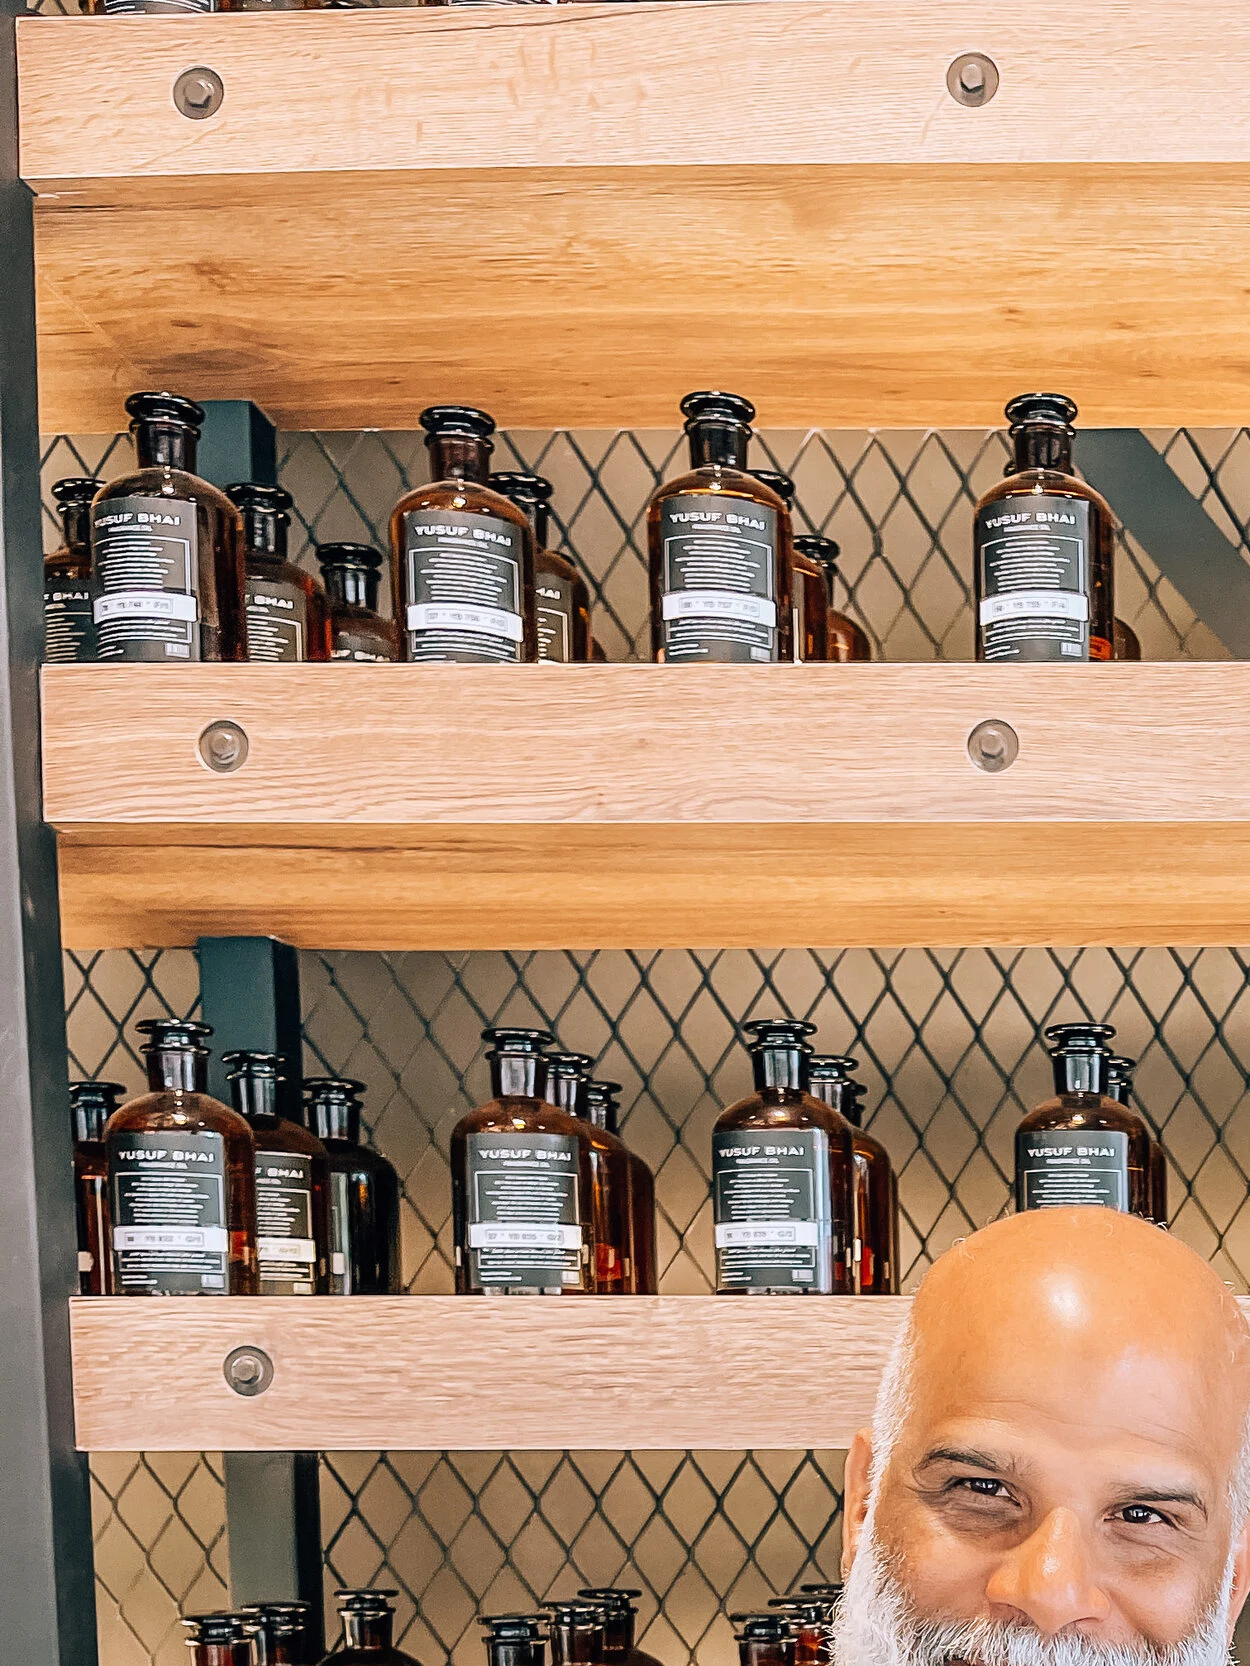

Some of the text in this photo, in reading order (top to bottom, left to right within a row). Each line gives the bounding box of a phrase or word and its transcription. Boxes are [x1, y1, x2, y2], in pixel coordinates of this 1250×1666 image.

[137, 513, 180, 526] BHAI
[670, 512, 722, 524] YUSUF
[726, 514, 767, 531] BHAI
[985, 513, 1032, 530] YUSUF
[1036, 512, 1076, 525] BHAI
[414, 525, 469, 537] YUSUF
[472, 529, 512, 547] BHAI
[254, 595, 294, 609] BHAI
[118, 1150, 214, 1162] YUSUF BHAI
[478, 1150, 572, 1162] YUSUF BHAI
[718, 1146, 804, 1158] YUSUF BHAI
[1027, 1148, 1115, 1158] YUSUF BHAI
[267, 1168, 304, 1178] BHAI
